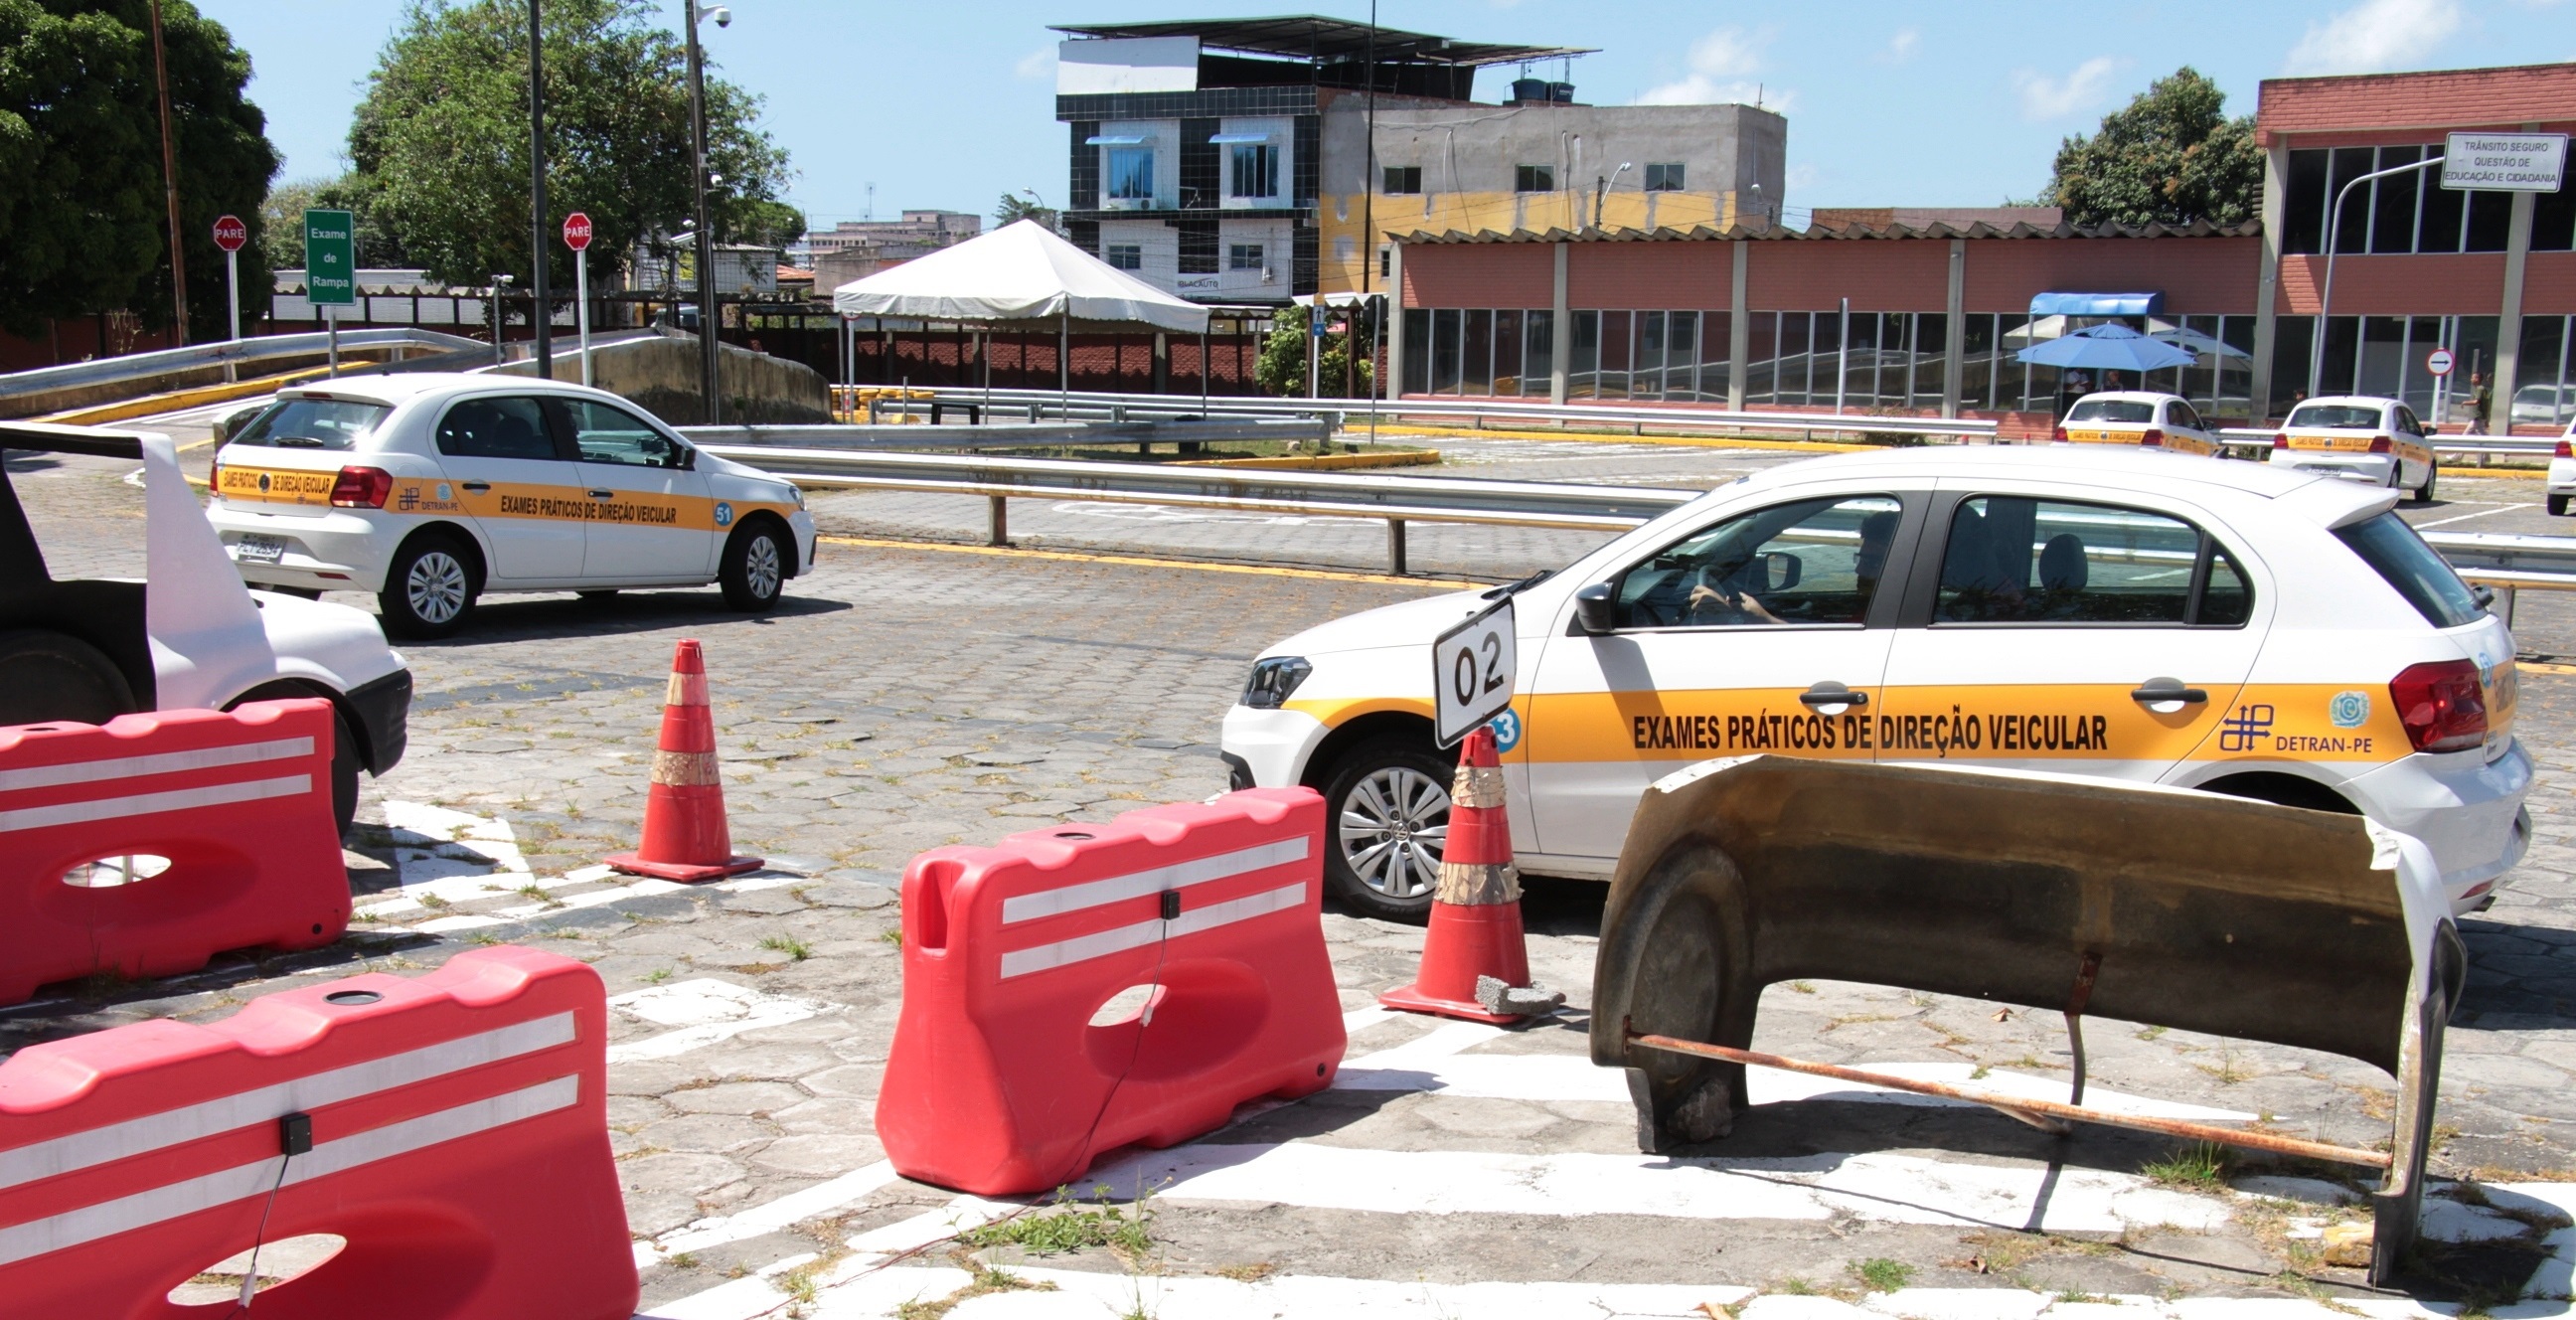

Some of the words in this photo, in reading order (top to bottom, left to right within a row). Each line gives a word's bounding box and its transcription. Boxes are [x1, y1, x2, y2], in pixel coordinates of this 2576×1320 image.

[2465, 140, 2507, 152] TRÂNSITO
[2510, 142, 2548, 152] SEGURO
[2475, 157, 2516, 167] QUESTÃO
[2518, 158, 2530, 167] DE
[2445, 171, 2496, 183] EDUCAÇÃO
[2497, 173, 2503, 182] E
[2506, 173, 2557, 183] CIDADANIA
[216, 229, 244, 239] PARE
[311, 228, 347, 240] Exame
[566, 226, 590, 239] PARE
[323, 252, 337, 263] de
[312, 276, 349, 289] Rampa
[421, 501, 458, 512] DETRAN-PE
[501, 495, 538, 515] EXAMES
[540, 496, 583, 518] PRÁTICOS
[584, 502, 596, 519] DE
[598, 501, 635, 524] DIREÇÃO
[636, 505, 677, 524] VEICULAR
[716, 506, 731, 522] 51
[1454, 630, 1505, 708] 02
[1633, 715, 1720, 749] EXAMES
[1728, 708, 1837, 749] PRÁTICOS
[1844, 715, 1872, 749] DE
[1880, 704, 1982, 758] DIREÇÃO
[1989, 715, 2108, 750] VEICULAR
[2276, 736, 2372, 753] DETRAN-PE
